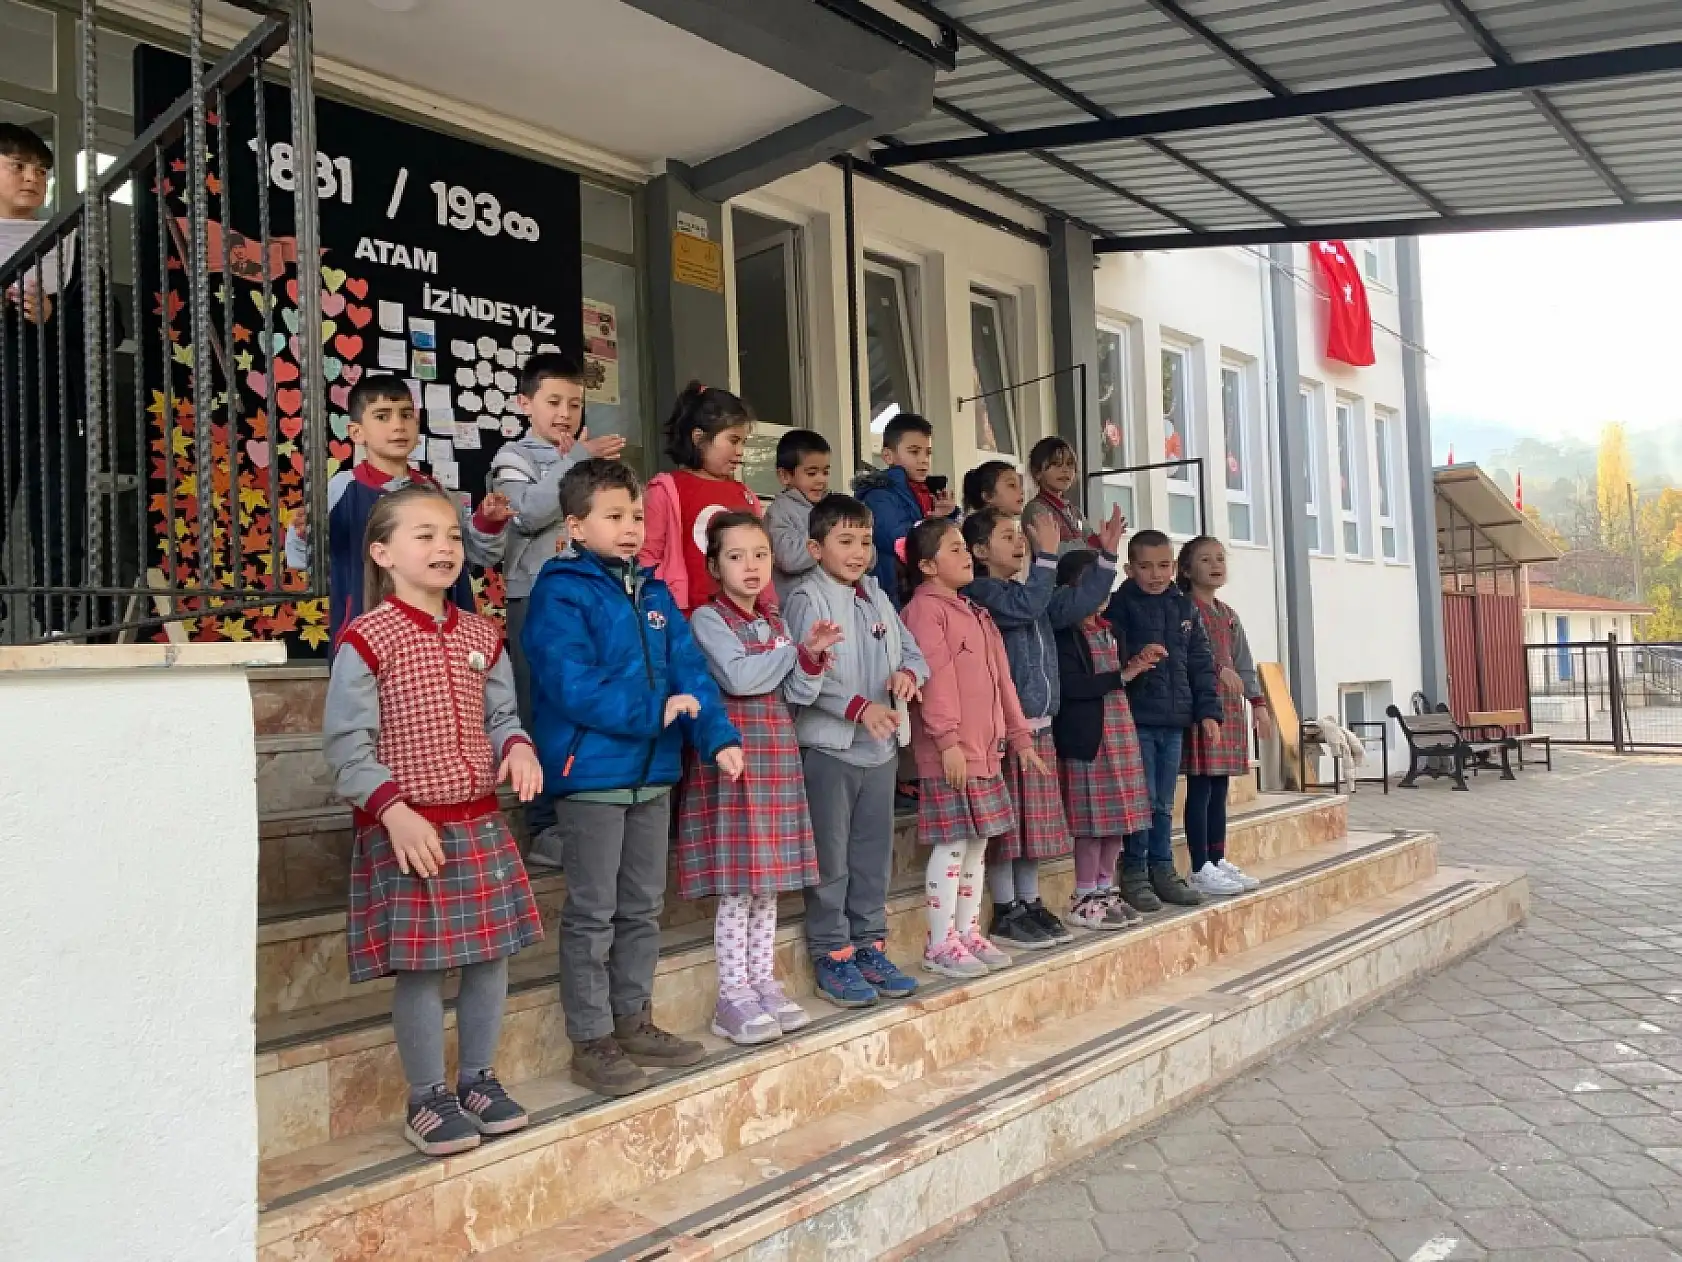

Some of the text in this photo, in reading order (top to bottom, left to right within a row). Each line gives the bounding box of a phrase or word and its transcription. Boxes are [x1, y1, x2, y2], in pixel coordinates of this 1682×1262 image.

[386, 167, 408, 219] /
[355, 237, 438, 275] ATAM
[422, 282, 557, 335] İZİNDEYİZ
